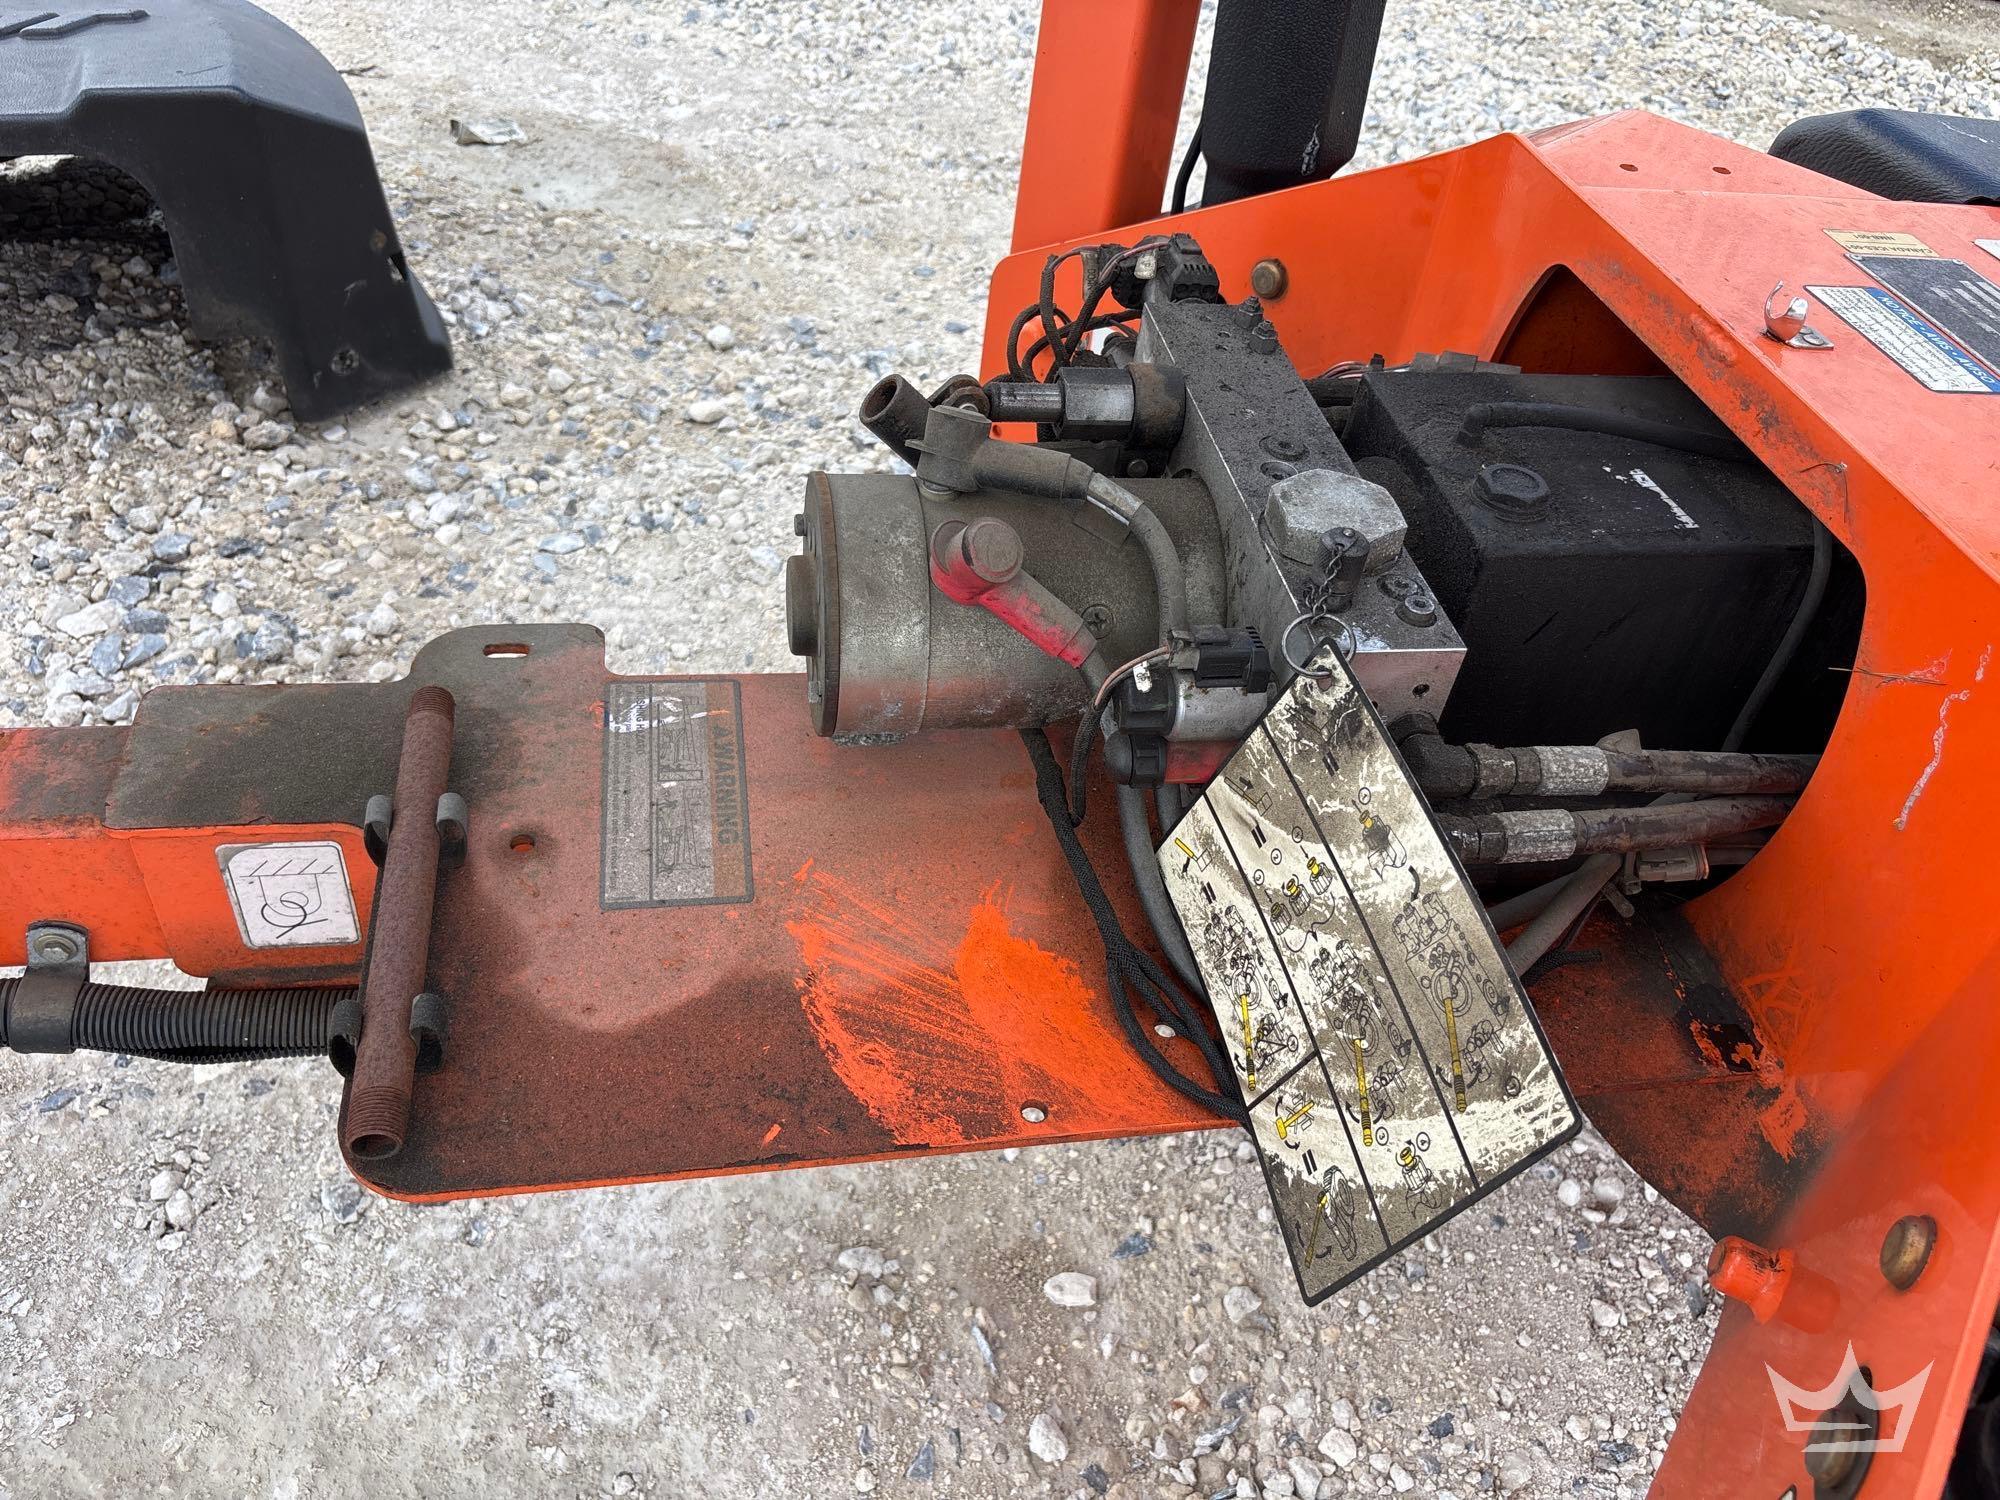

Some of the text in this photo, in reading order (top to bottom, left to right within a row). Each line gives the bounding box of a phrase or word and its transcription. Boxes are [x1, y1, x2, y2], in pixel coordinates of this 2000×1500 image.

[1878, 295, 1996, 383] NOTICE AVIS AVISO
[634, 685, 647, 755] CRUSHING HAZARD
[713, 741, 741, 845] WARNING
